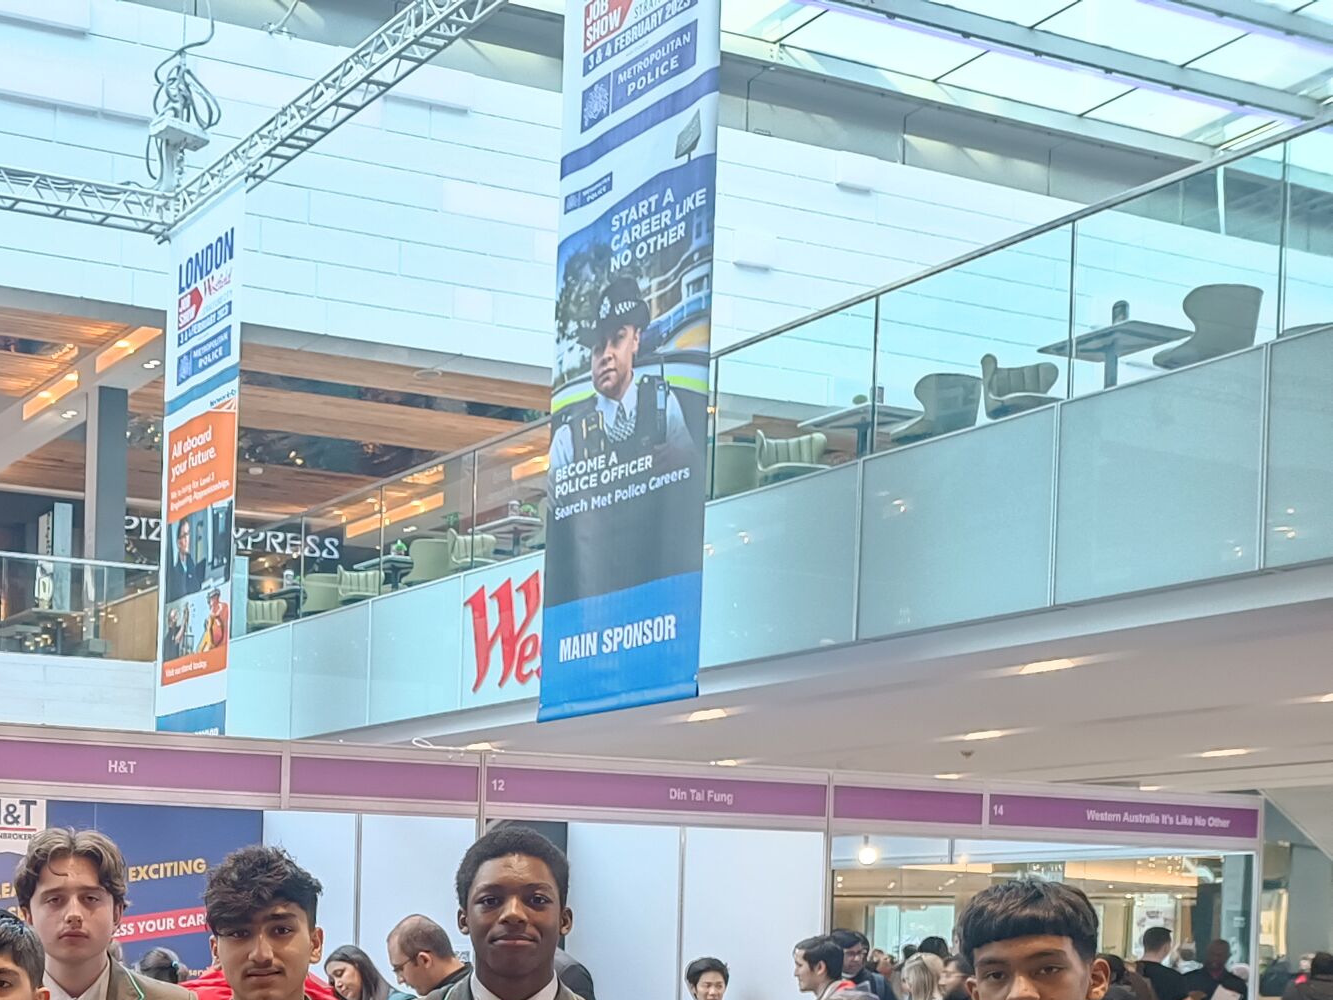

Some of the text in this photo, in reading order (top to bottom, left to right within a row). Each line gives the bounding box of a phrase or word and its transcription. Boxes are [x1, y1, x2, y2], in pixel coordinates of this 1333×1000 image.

[586, 7, 622, 47] SHOW
[614, 8, 664, 53] FEBRUARY
[617, 32, 691, 85] METROPOLITAN
[627, 55, 679, 97] POLICE
[611, 187, 674, 232] START A
[611, 188, 707, 251] CAREER LIKE
[178, 226, 234, 295] LONDON
[610, 221, 685, 272] NO OTHER
[198, 346, 223, 369] POLICE
[171, 424, 212, 460] All aboard
[170, 460, 188, 482] your
[555, 451, 618, 483] BECOME A
[555, 455, 653, 499] POLICE OFFICER
[554, 467, 690, 520] Search Met Police Careers
[124, 515, 340, 559] PIZ XPRESS
[559, 614, 677, 663] MAIN SPONSOR
[107, 759, 137, 774] H&T
[491, 779, 505, 792] 12
[669, 788, 687, 801] Din
[707, 790, 734, 805] Fung
[993, 805, 1004, 816] 14
[1086, 809, 1121, 823] Western
[1123, 811, 1160, 825] Australia
[1194, 815, 1206, 827] No
[1208, 816, 1230, 828] Other
[128, 858, 207, 882] EXCITING
[137, 917, 175, 934] YOUR
[178, 913, 208, 928] CAR
